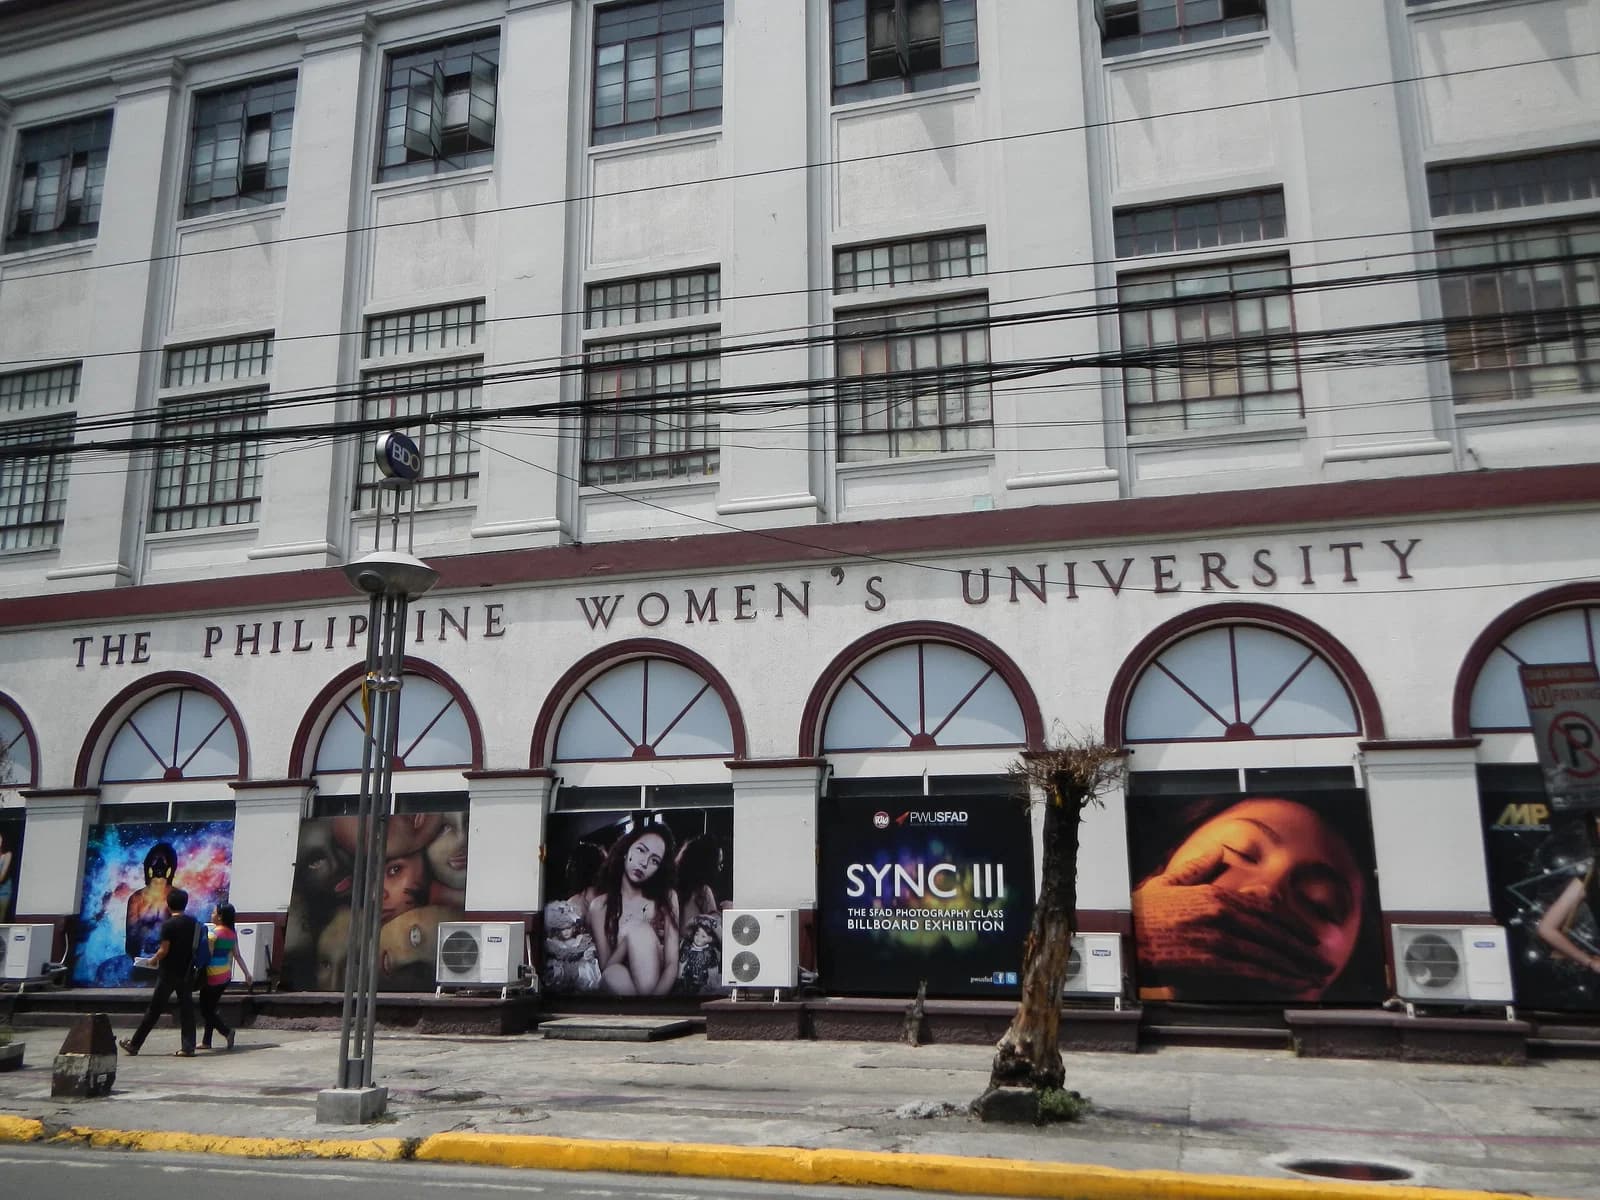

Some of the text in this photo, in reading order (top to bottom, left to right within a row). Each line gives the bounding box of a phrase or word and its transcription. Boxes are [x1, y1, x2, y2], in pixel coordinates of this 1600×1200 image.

[392, 442, 421, 472] BDO
[72, 538, 1422, 668] THE PHILIPINE WOMEN'S UNIVERSITY
[910, 811, 969, 823] PWUSFAD
[846, 863, 1005, 899] SYNC III
[848, 908, 1004, 919] THE SFAD PHOTOGRAPHY CLASS
[847, 919, 1005, 932] BILLBOARD EXHIBITION
